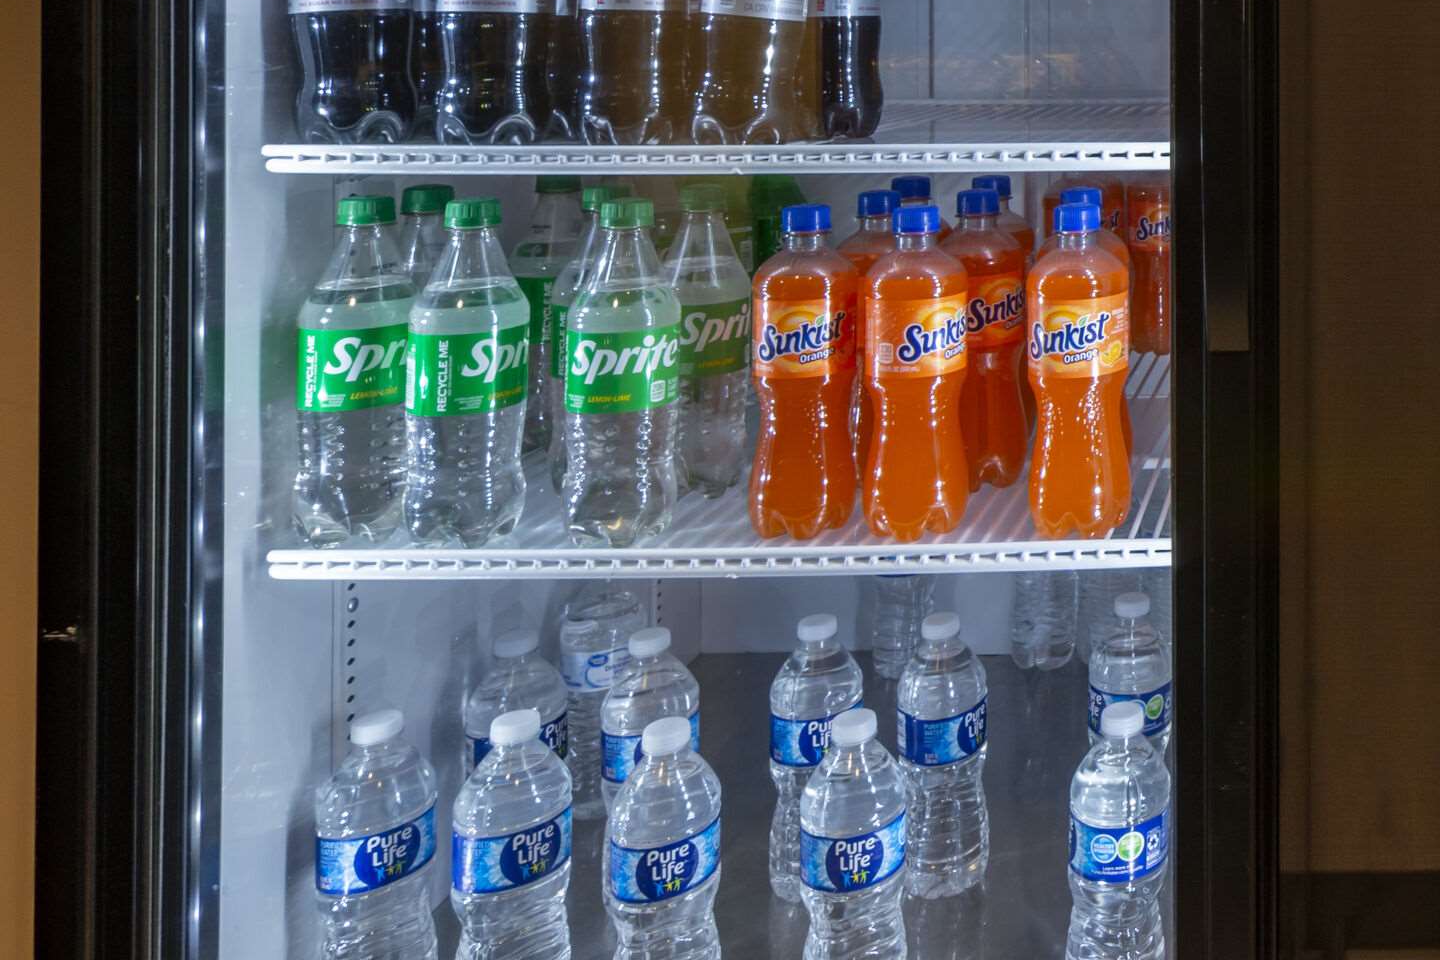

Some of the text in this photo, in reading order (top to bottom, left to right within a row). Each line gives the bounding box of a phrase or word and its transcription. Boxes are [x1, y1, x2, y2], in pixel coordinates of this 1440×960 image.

[758, 311, 845, 364] Sunkist
[1031, 312, 1110, 360] Sunkist
[571, 334, 679, 385] Sprite
[799, 346, 836, 364] Orange
[1063, 348, 1099, 365] Orange
[305, 335, 316, 408] RECYCLE ME
[437, 340, 449, 412] RECYCLE ME
[964, 703, 986, 728] Pure
[366, 823, 413, 853] Pure
[512, 822, 555, 853] Pure
[833, 836, 877, 856] Pure
[372, 843, 407, 868] Life
[517, 842, 551, 866] Life
[646, 841, 690, 868] Pure
[839, 853, 872, 874] Life
[651, 859, 686, 884] Life
